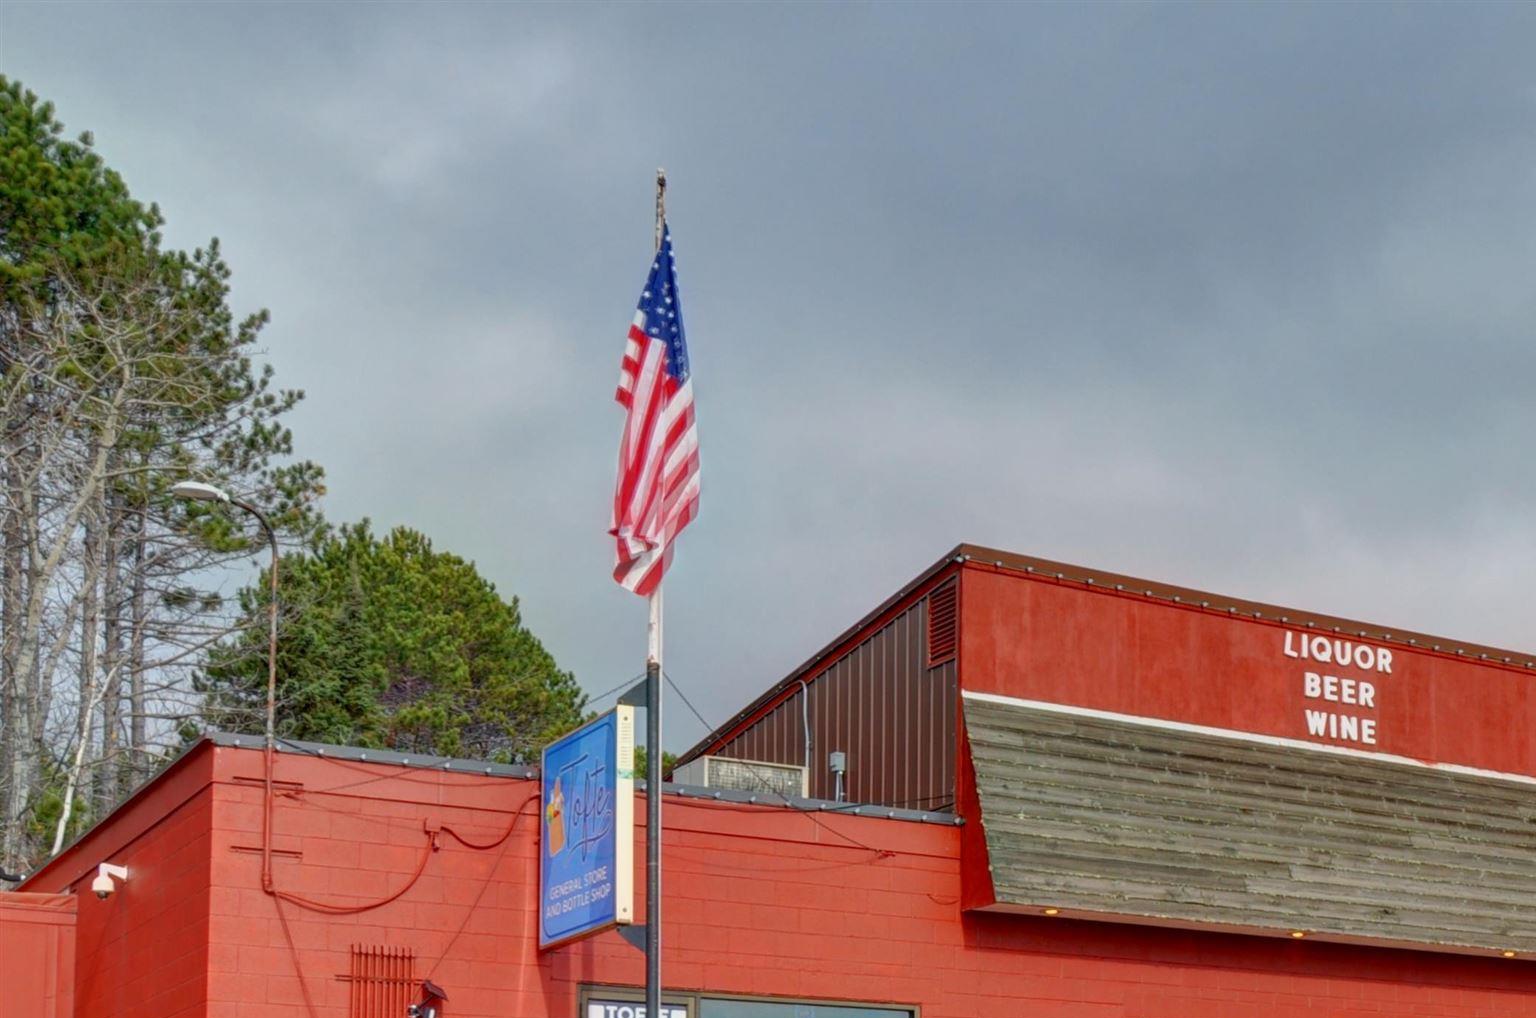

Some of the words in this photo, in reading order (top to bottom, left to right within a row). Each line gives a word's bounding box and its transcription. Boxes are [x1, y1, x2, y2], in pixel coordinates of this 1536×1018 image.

[1283, 631, 1393, 674] LIQUOR
[1304, 672, 1375, 707] BEER
[1305, 709, 1377, 744] WINE
[560, 753, 612, 863] Tofte
[546, 901, 561, 919] AND
[562, 891, 590, 914] BOTTLE
[590, 882, 612, 903] SHOP
[550, 876, 582, 900] GENERAL
[584, 866, 608, 888] STORE
